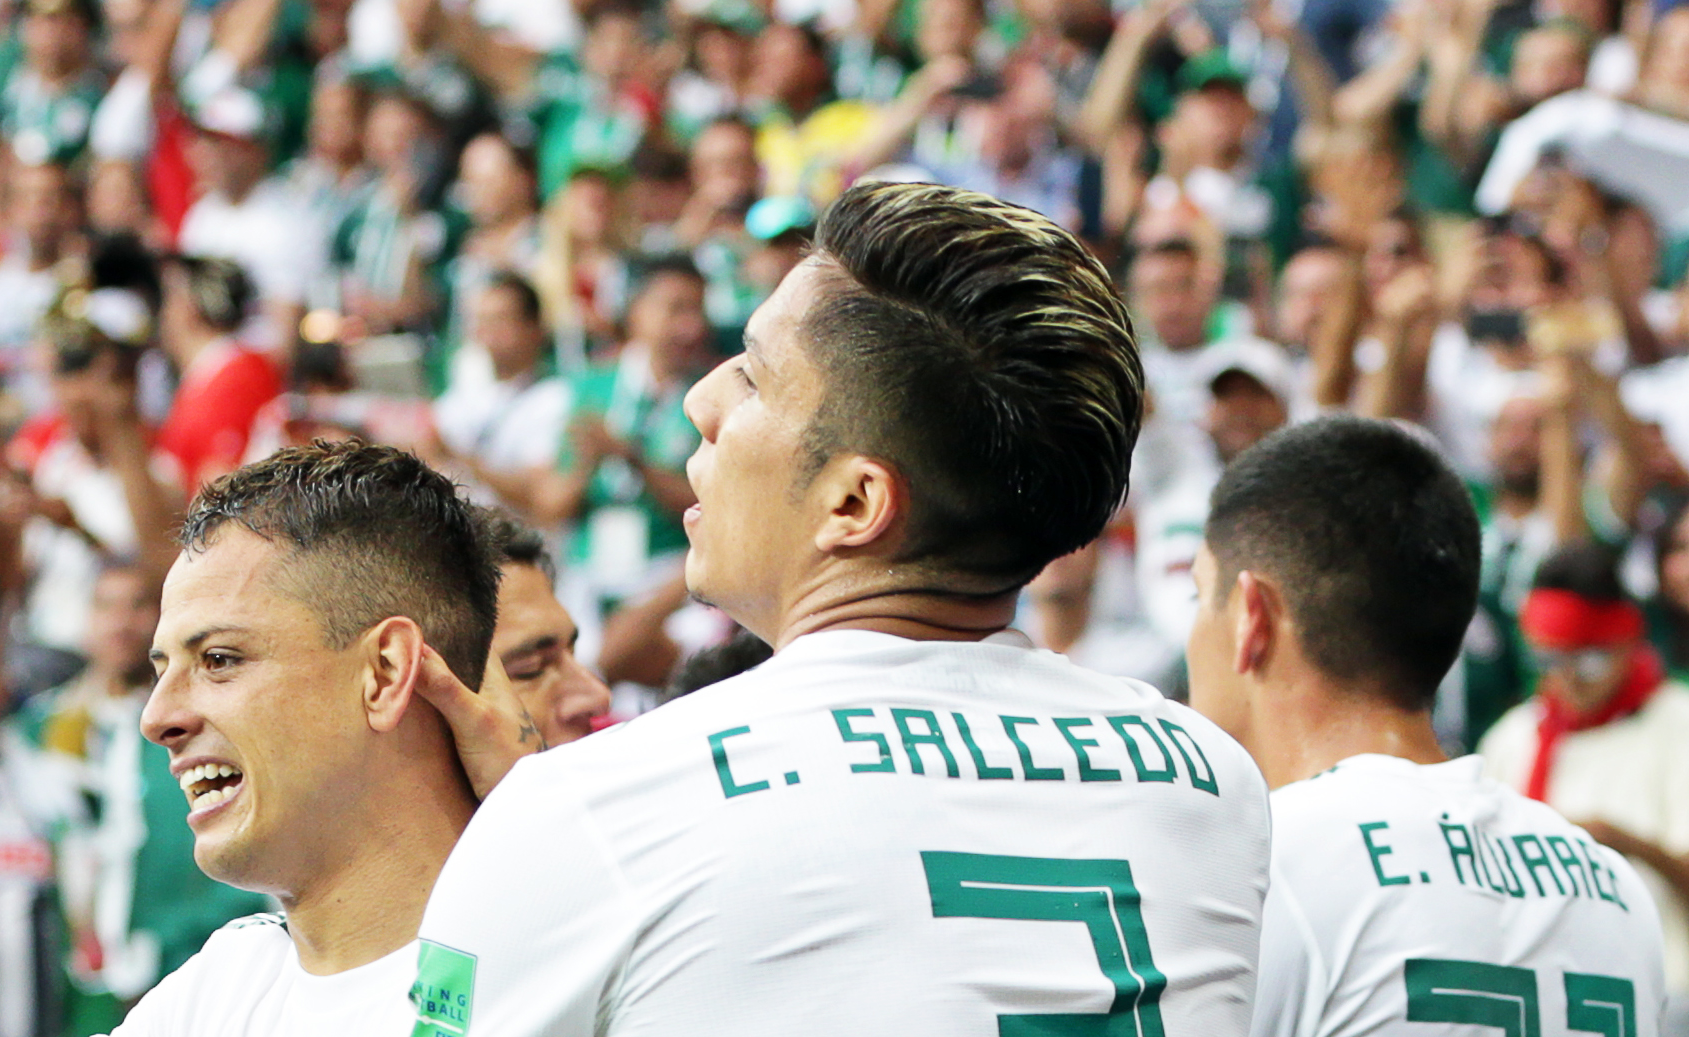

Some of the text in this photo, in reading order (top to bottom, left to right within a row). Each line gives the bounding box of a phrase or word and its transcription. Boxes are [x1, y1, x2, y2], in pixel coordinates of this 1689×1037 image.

[708, 707, 1220, 798] C. SALCEDO
[1357, 821, 1431, 887] E.
